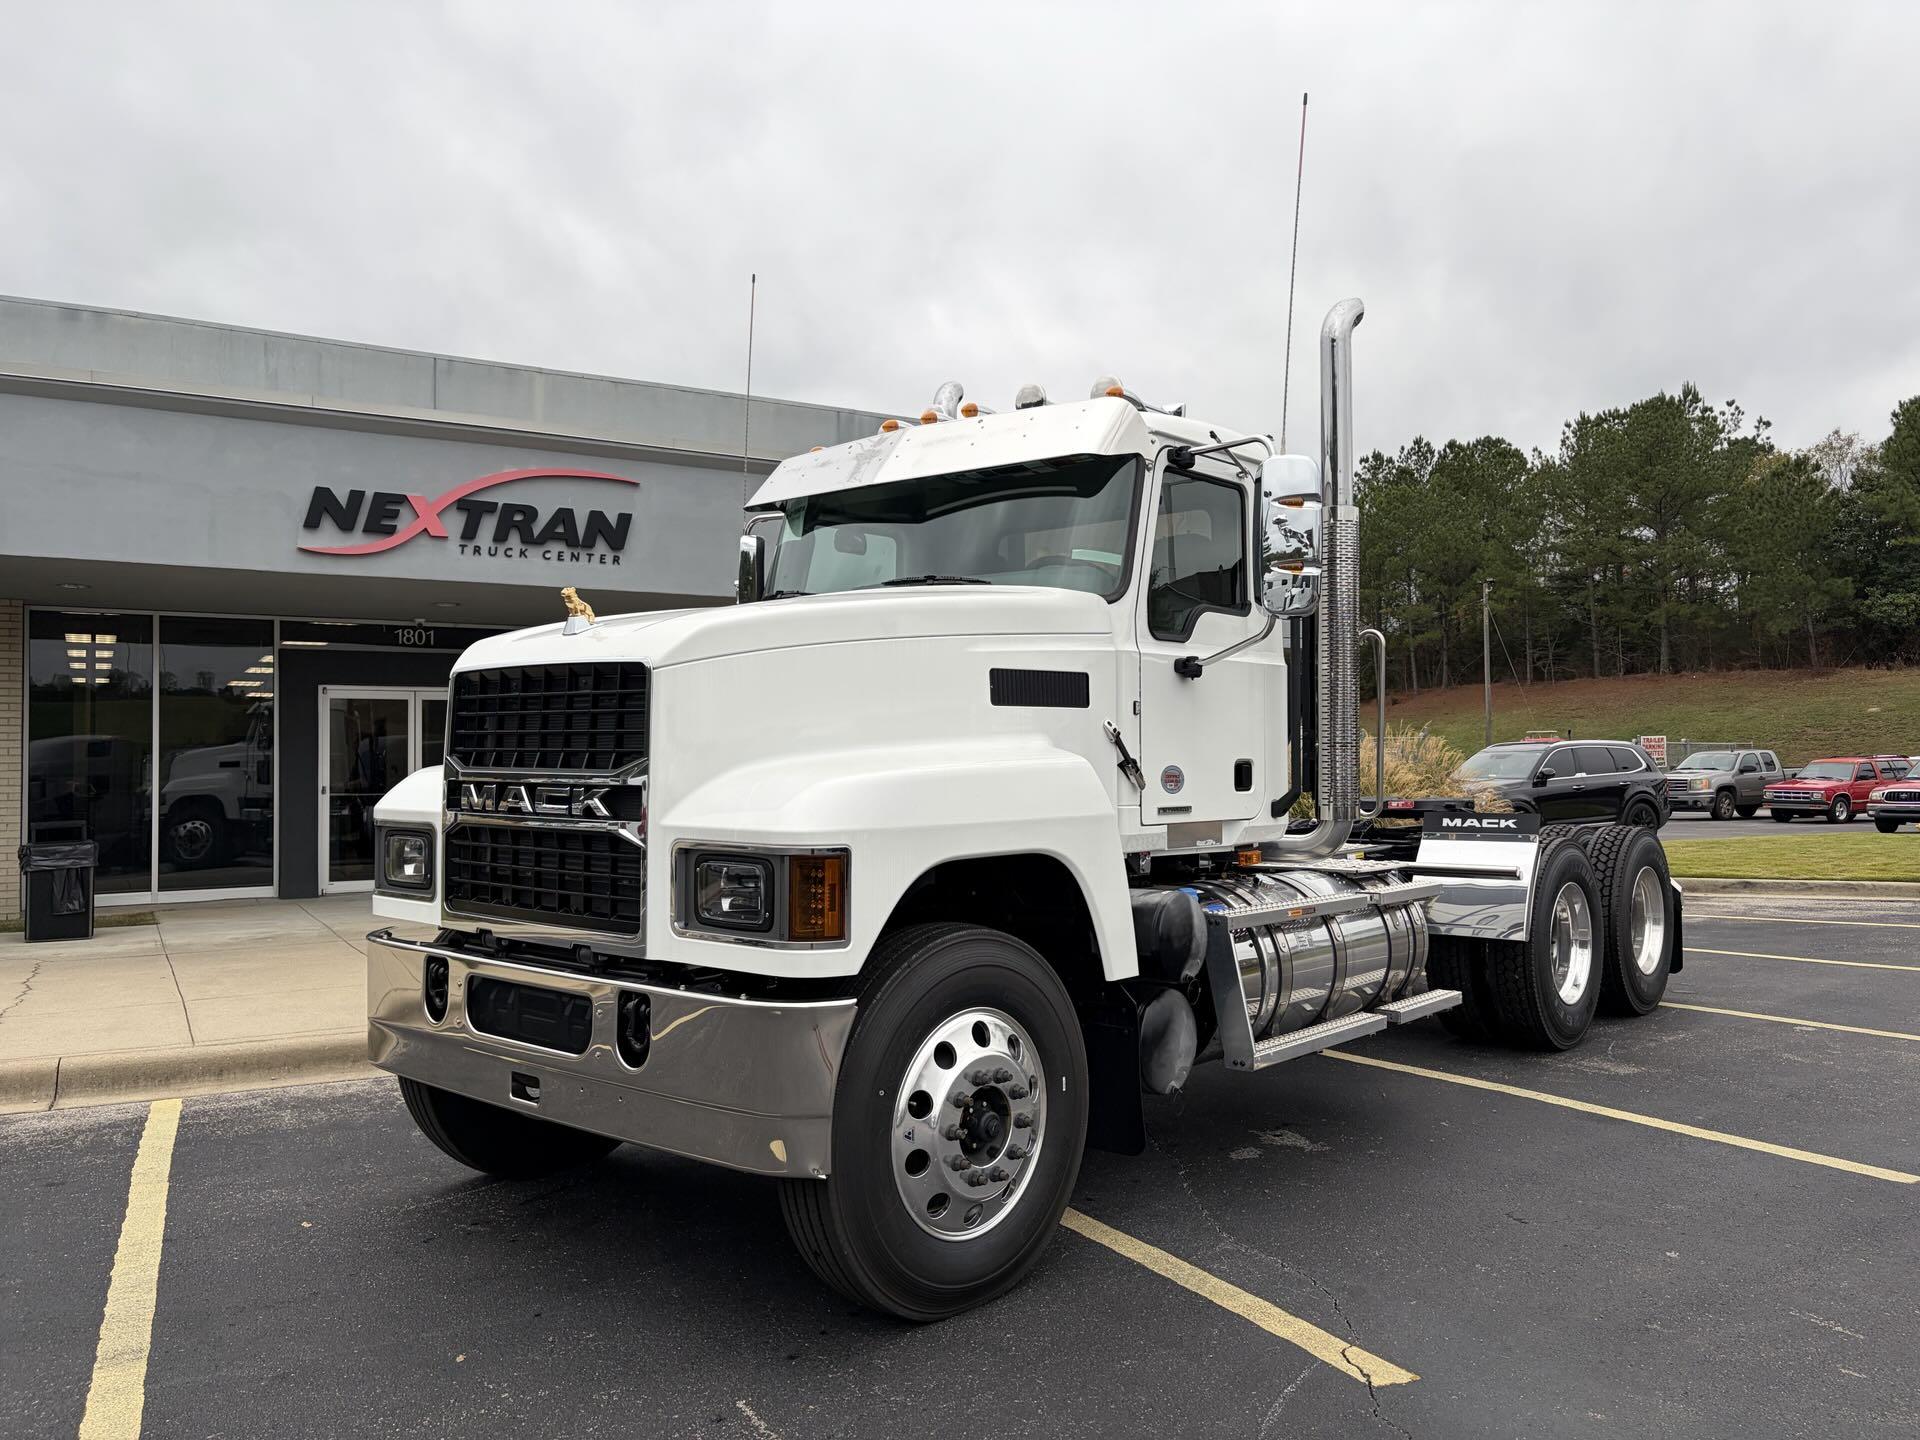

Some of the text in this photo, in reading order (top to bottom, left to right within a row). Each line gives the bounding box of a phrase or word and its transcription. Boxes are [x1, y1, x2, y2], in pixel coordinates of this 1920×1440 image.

[302, 486, 633, 551] NEXTRAN
[458, 543, 622, 566] TRUCK CENTER
[394, 628, 434, 646] 1801
[461, 783, 612, 817] MACK
[1441, 817, 1518, 829] MACK
